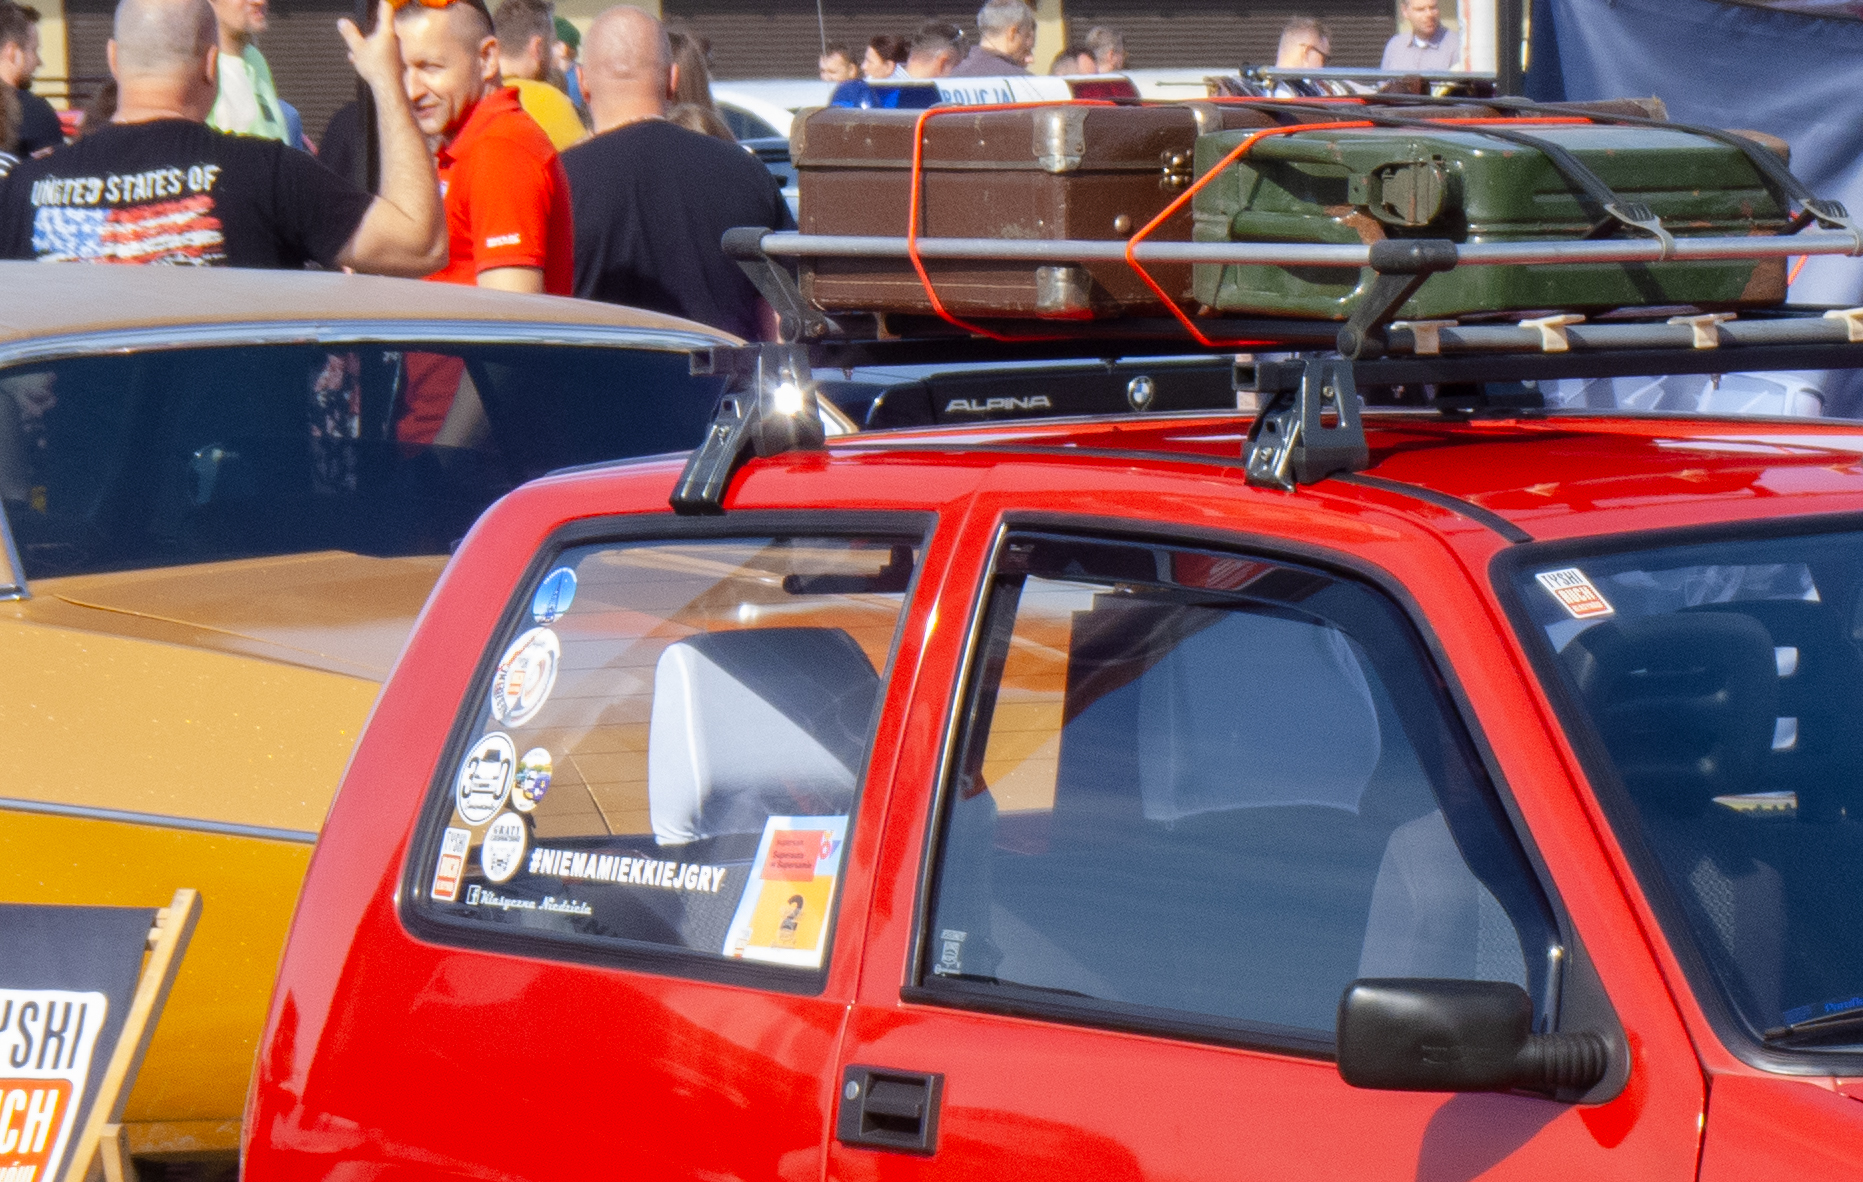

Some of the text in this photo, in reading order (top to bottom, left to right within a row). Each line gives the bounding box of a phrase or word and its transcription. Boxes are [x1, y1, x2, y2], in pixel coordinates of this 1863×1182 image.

[31, 164, 221, 206] UNITED STATES OF
[944, 395, 1052, 412] ALPINA
[780, 894, 804, 931] 2
[0, 1000, 88, 1070] SKI
[0, 1088, 60, 1155] CH
